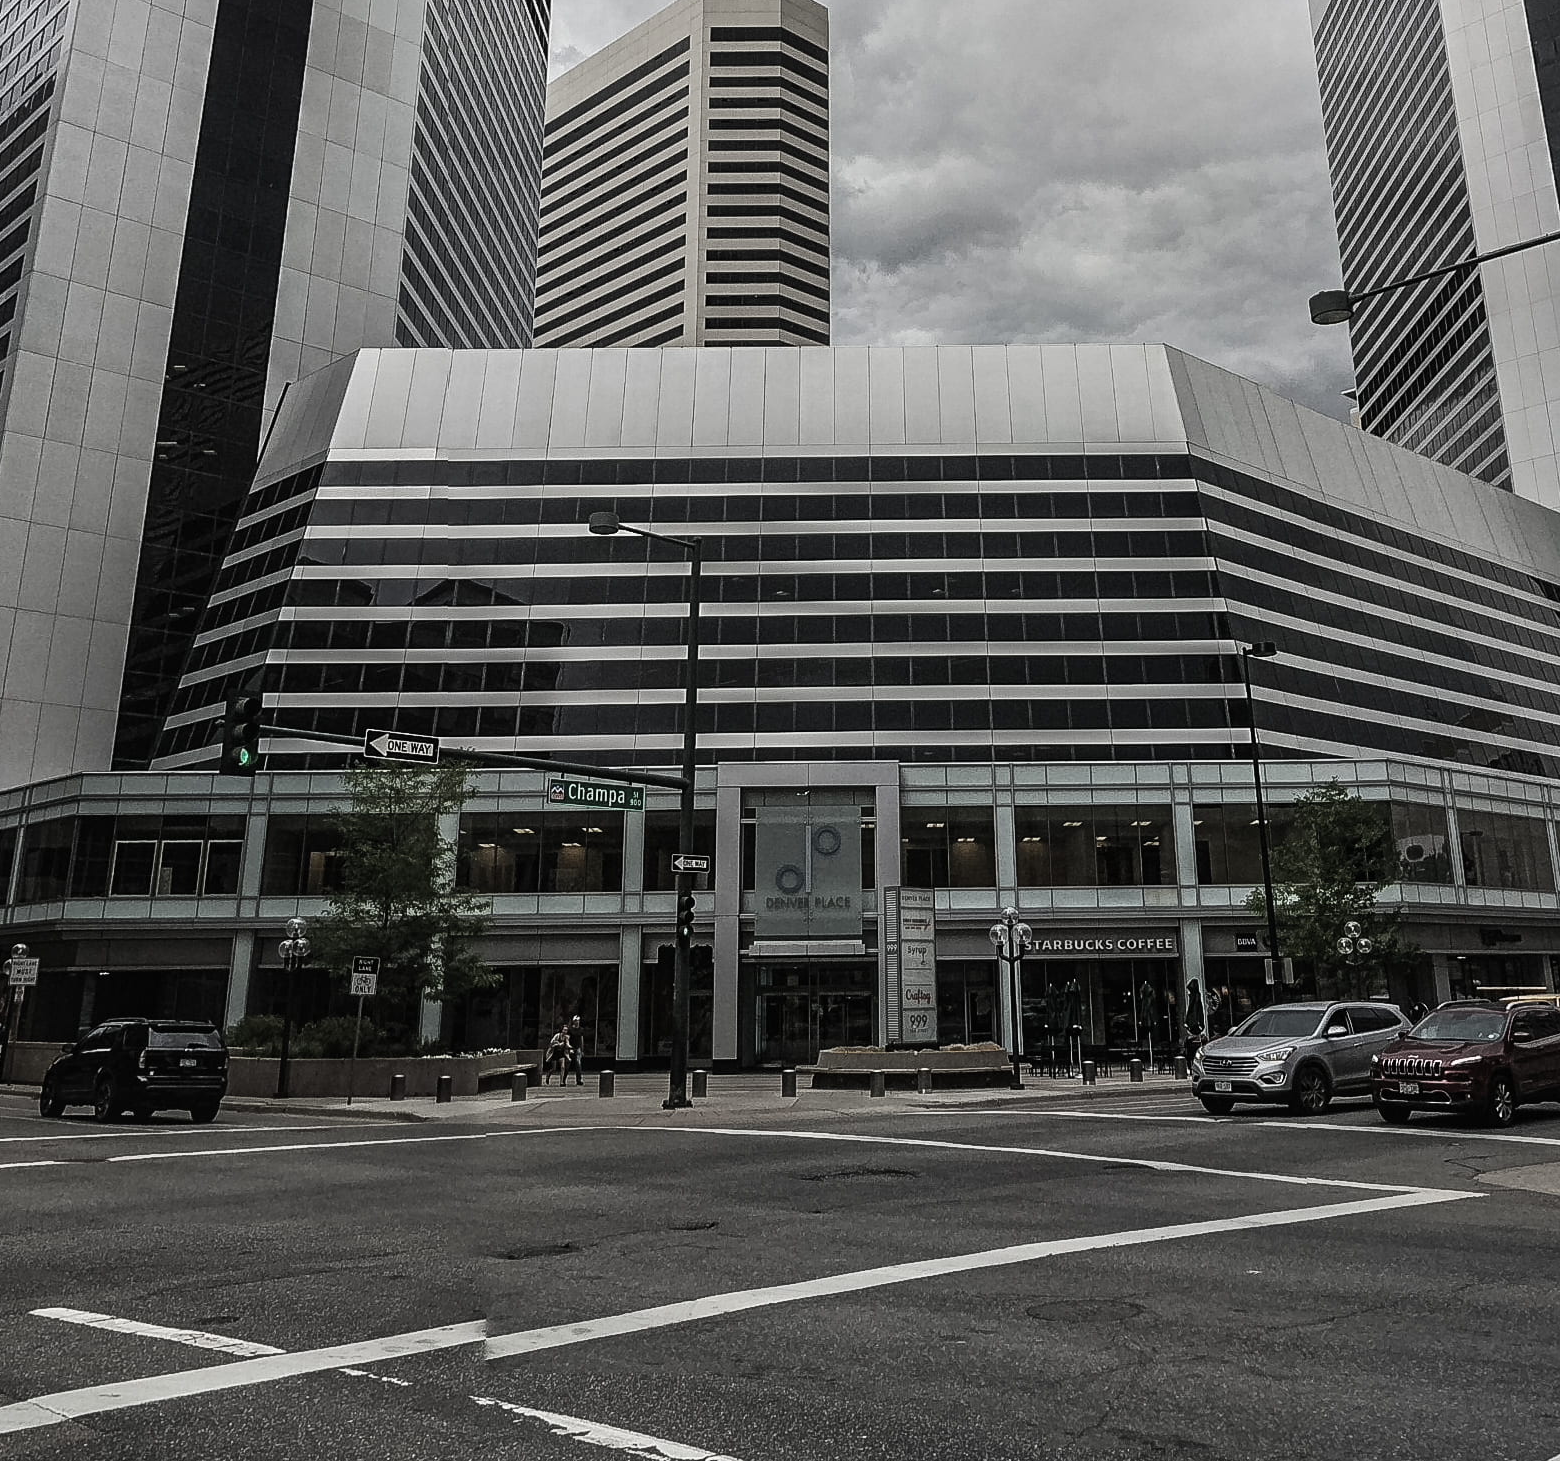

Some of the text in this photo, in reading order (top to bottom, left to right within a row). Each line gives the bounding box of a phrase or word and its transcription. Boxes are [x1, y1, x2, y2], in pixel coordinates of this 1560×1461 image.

[387, 740, 431, 755] ONE WAY
[568, 782, 626, 807] Champa
[629, 798, 642, 807] 900
[683, 860, 694, 868] ONE
[766, 896, 851, 909] DENVER PLACE
[907, 945, 927, 956] Syrup
[1025, 938, 1173, 951] STARBUCKS COFFEE
[355, 985, 371, 993] ONLY
[910, 1014, 928, 1028] 999
